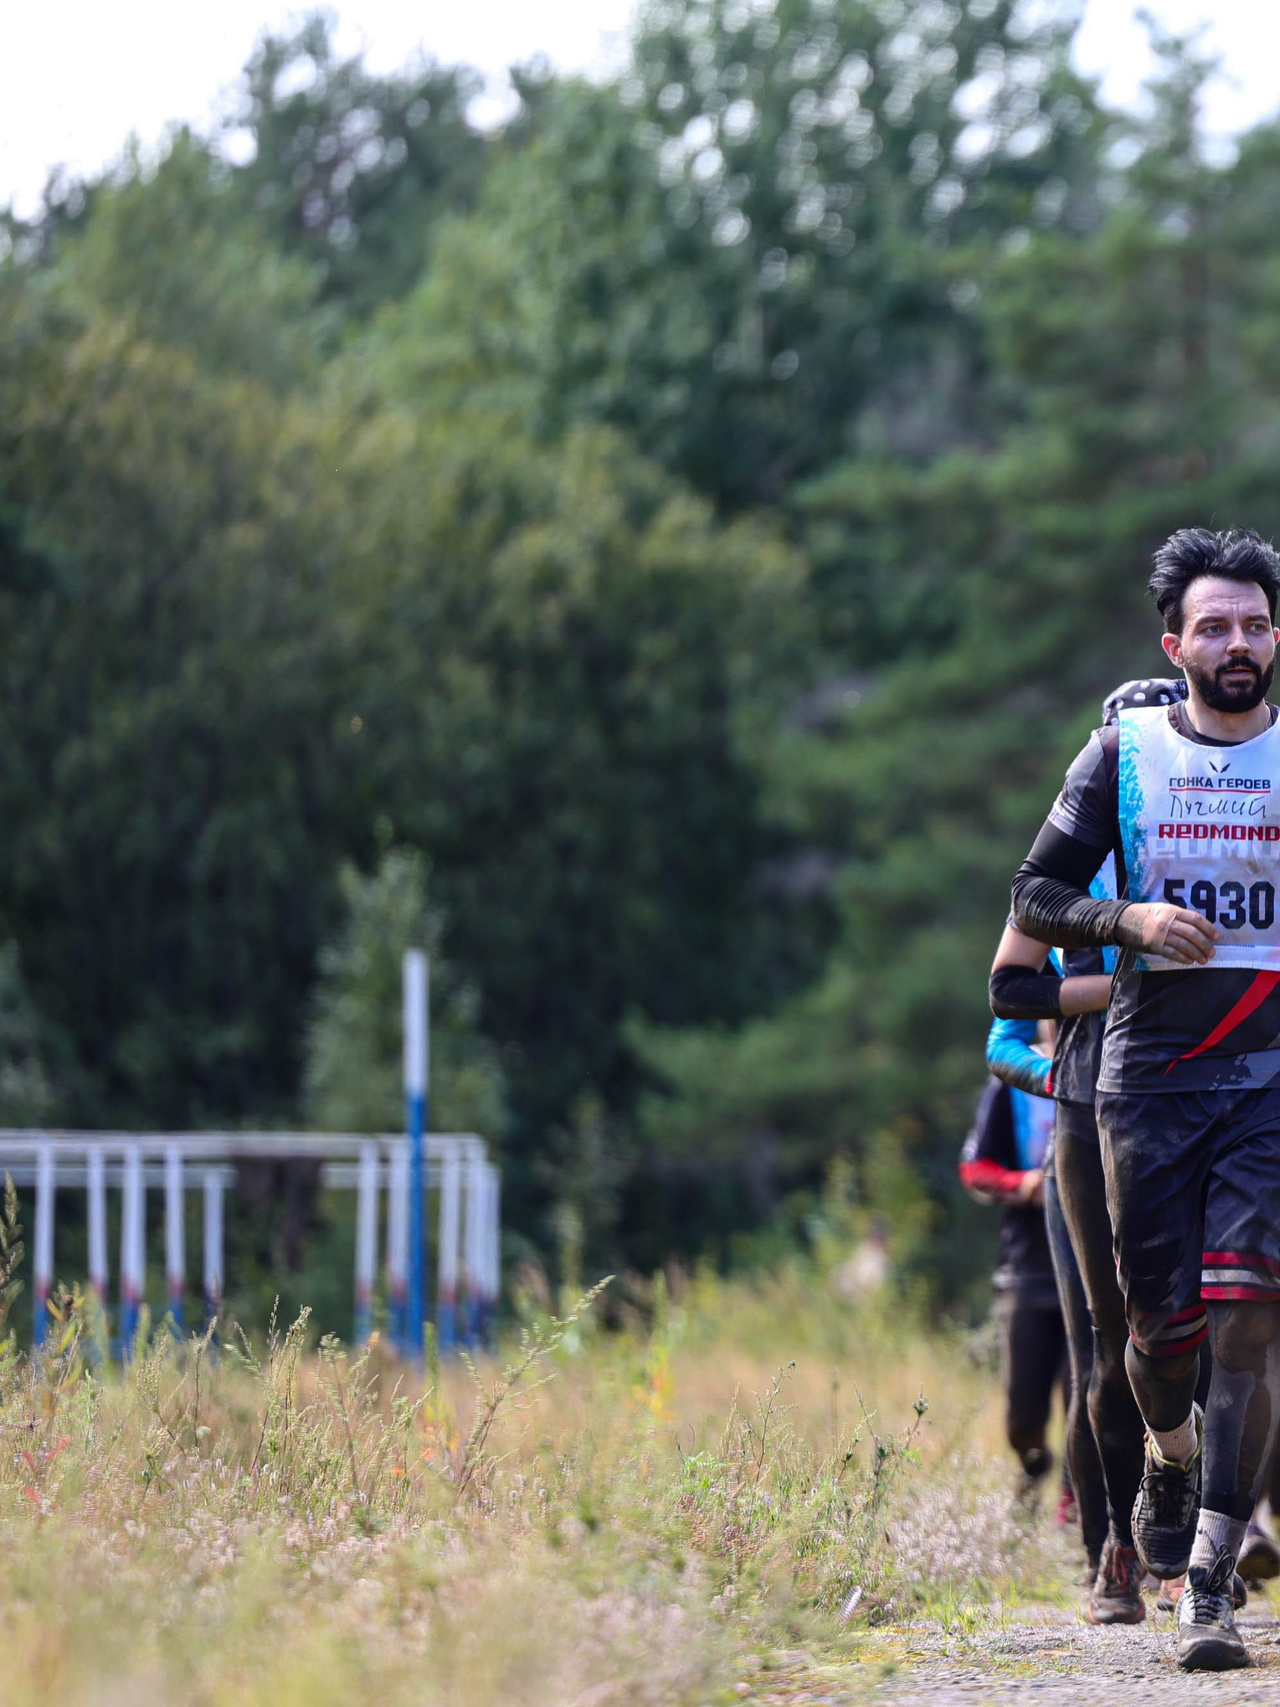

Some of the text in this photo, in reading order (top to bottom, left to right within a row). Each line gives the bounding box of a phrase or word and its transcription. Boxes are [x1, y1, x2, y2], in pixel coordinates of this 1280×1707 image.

[1169, 776, 1271, 790] ГОНКА ГЕРОЕВ
[1163, 878, 1276, 930] 5930
